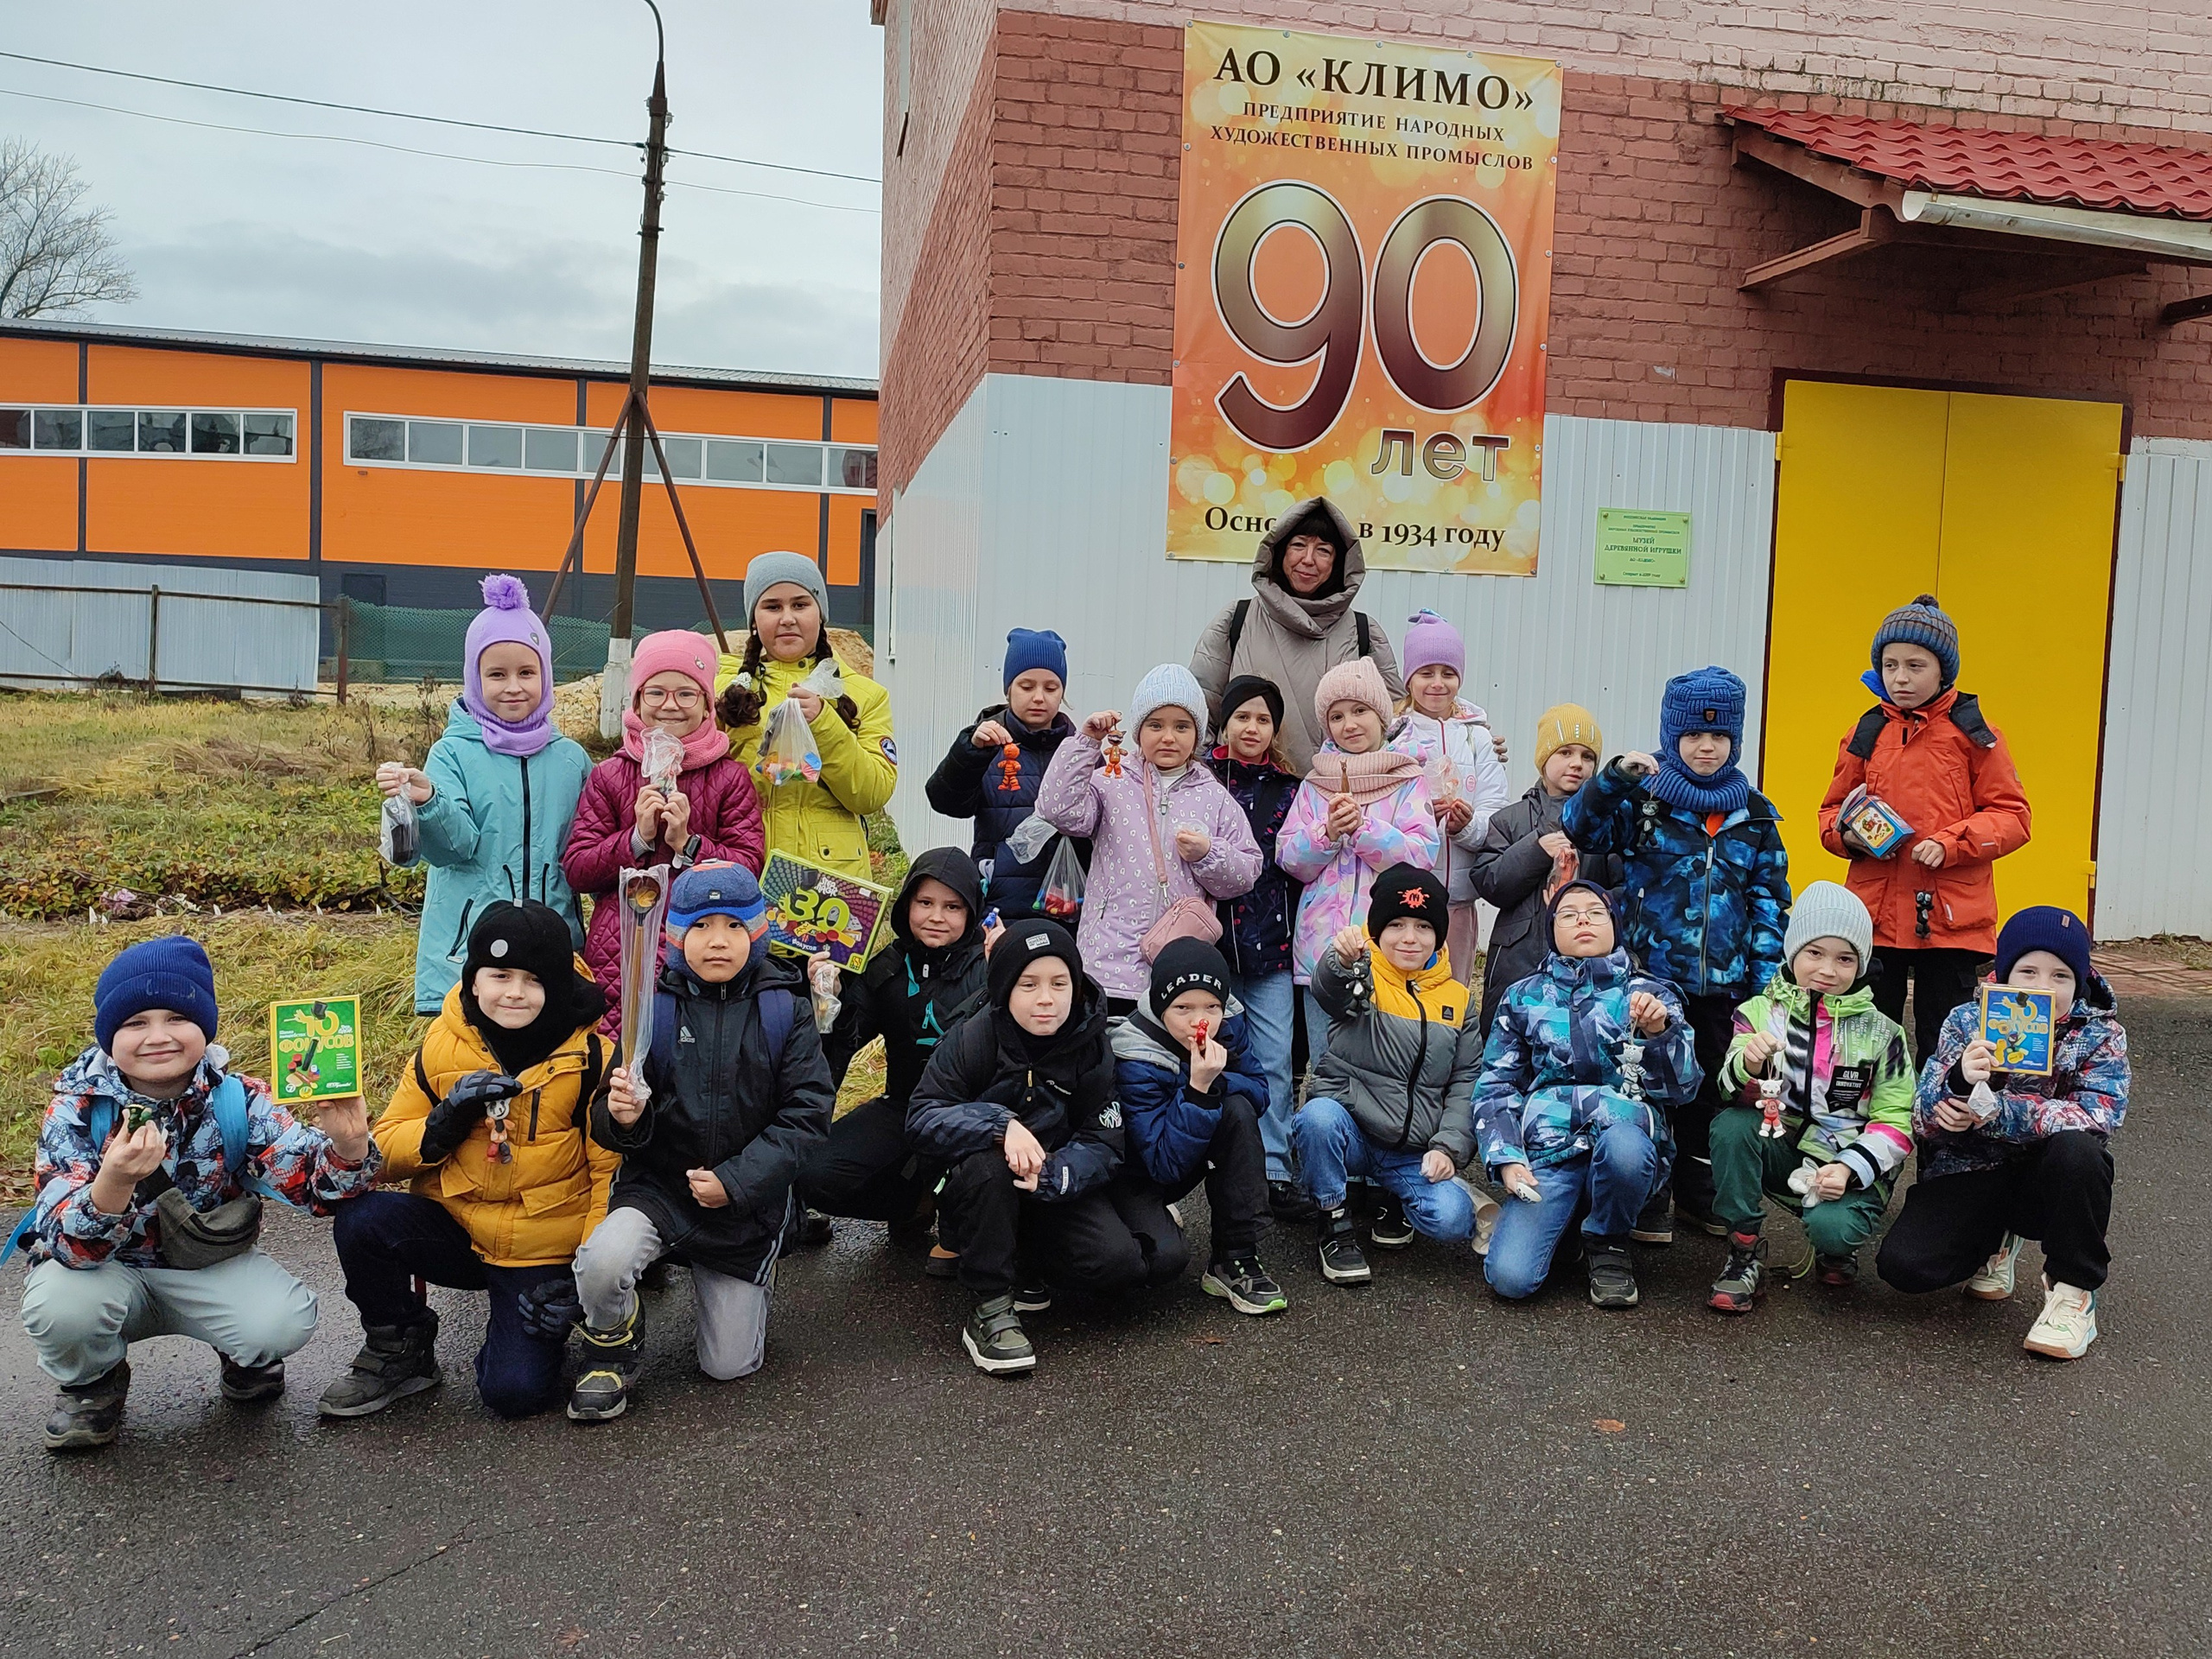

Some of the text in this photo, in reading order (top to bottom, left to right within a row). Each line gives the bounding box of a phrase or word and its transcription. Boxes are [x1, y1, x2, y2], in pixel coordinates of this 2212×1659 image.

[1212, 48, 1534, 111] АО «КЛИМО»
[1243, 102, 1504, 142] ПРЕДПРИЯТИЕ НАРОДНЫХ
[1211, 125, 1534, 170] ХУДОЖЕСТВЕННЫХ ПРОМЫСЛОВ
[1211, 179, 1519, 453] 90
[1371, 429, 1510, 481] лет
[1359, 522, 1373, 538] в
[1382, 524, 1438, 547] 1934
[1444, 528, 1506, 553] году
[1605, 544, 1649, 553] ДЕРЕВЯННОЙ
[778, 887, 850, 932] 30
[1160, 973, 1222, 1000] LEADER
